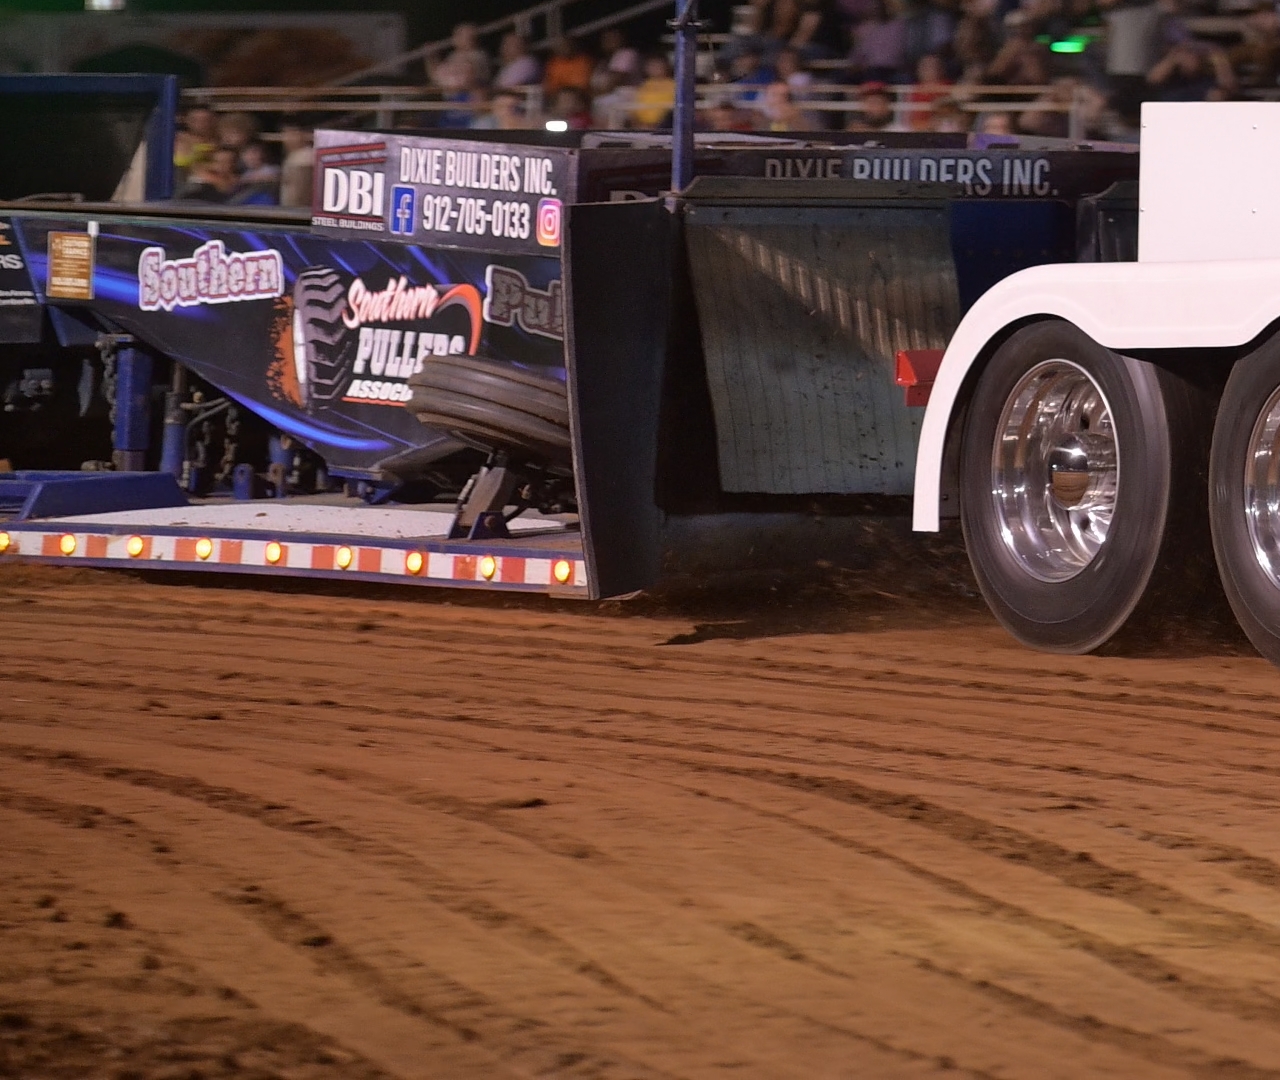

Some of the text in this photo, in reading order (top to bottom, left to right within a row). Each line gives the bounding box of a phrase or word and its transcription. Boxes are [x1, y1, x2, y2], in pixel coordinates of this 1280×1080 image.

[323, 167, 386, 216] DBI
[400, 146, 557, 196] DIXIE BUILDERS INC.
[1002, 158, 1059, 197] INC.
[311, 216, 385, 232] STEEL BUILDINGS
[423, 194, 531, 240] 912-705-0133
[140, 241, 283, 311] Southern
[342, 275, 440, 329] Southern
